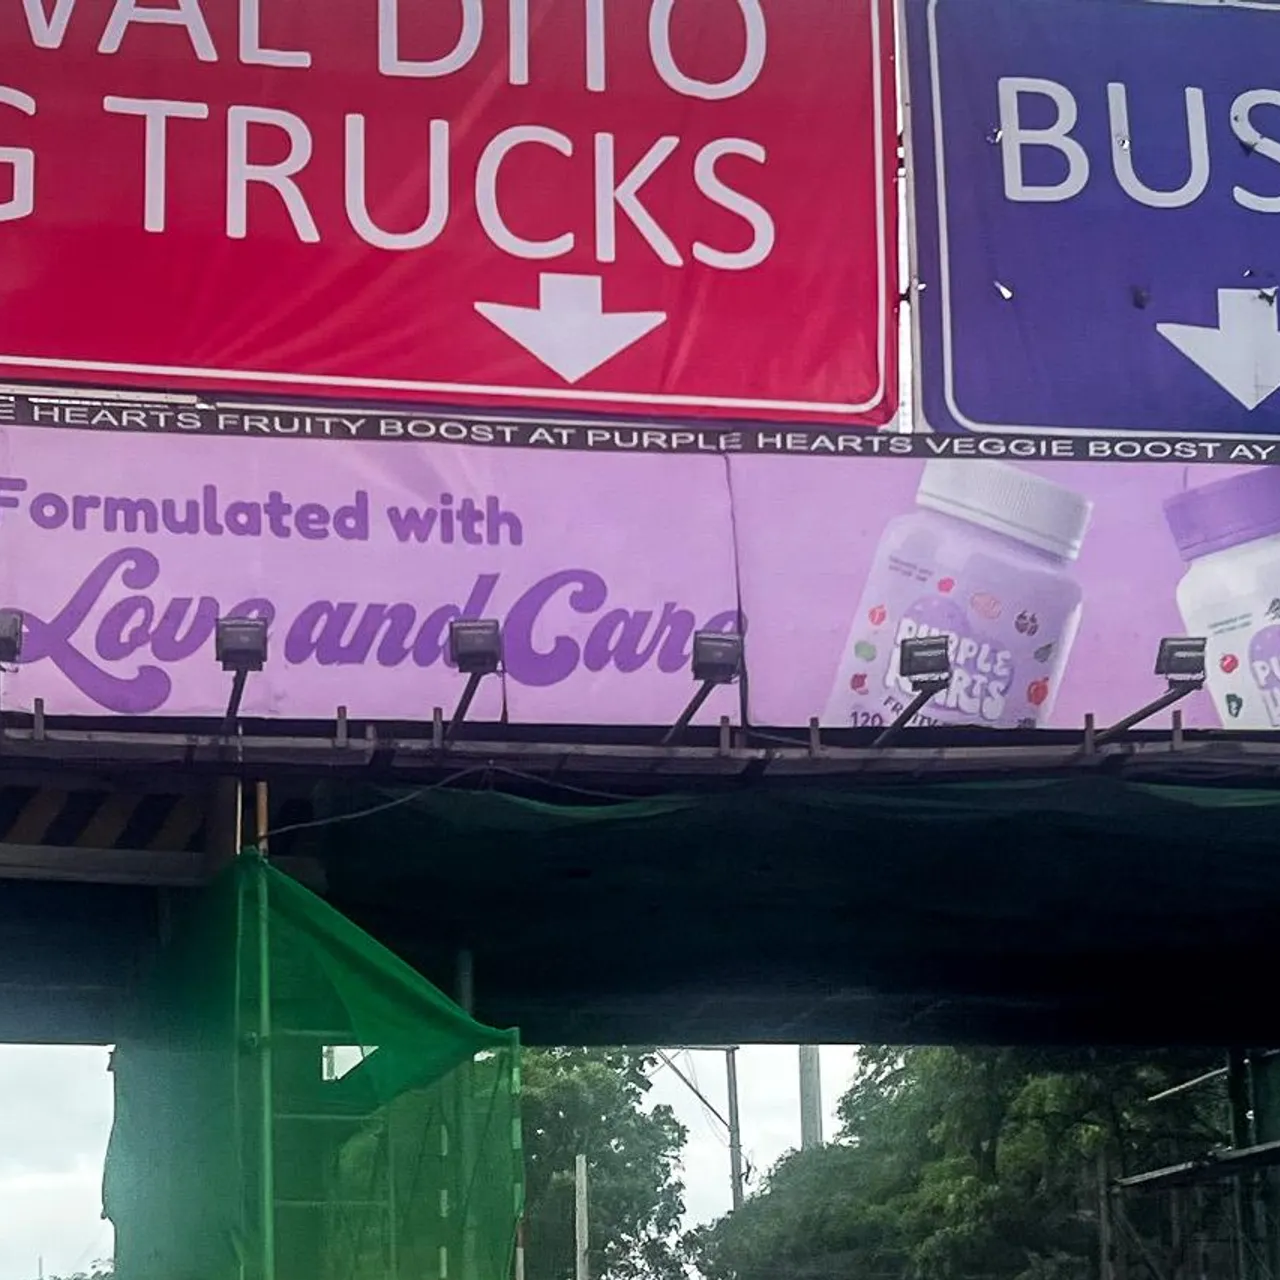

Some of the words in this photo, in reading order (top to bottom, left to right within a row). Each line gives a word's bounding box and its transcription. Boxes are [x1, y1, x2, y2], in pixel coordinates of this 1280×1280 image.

[102, 93, 778, 272] TRUCKS
[33, 402, 204, 431] HEARTS
[217, 412, 373, 437] FRUITY
[379, 419, 519, 444] BOOST
[528, 427, 577, 447] AT
[586, 430, 743, 451] PURPLE
[756, 431, 914, 455] HEARTS
[926, 437, 1076, 457] VEGGIE
[1088, 440, 1223, 461] BOOST
[1228, 443, 1277, 462] AY
[386, 492, 524, 547] with
